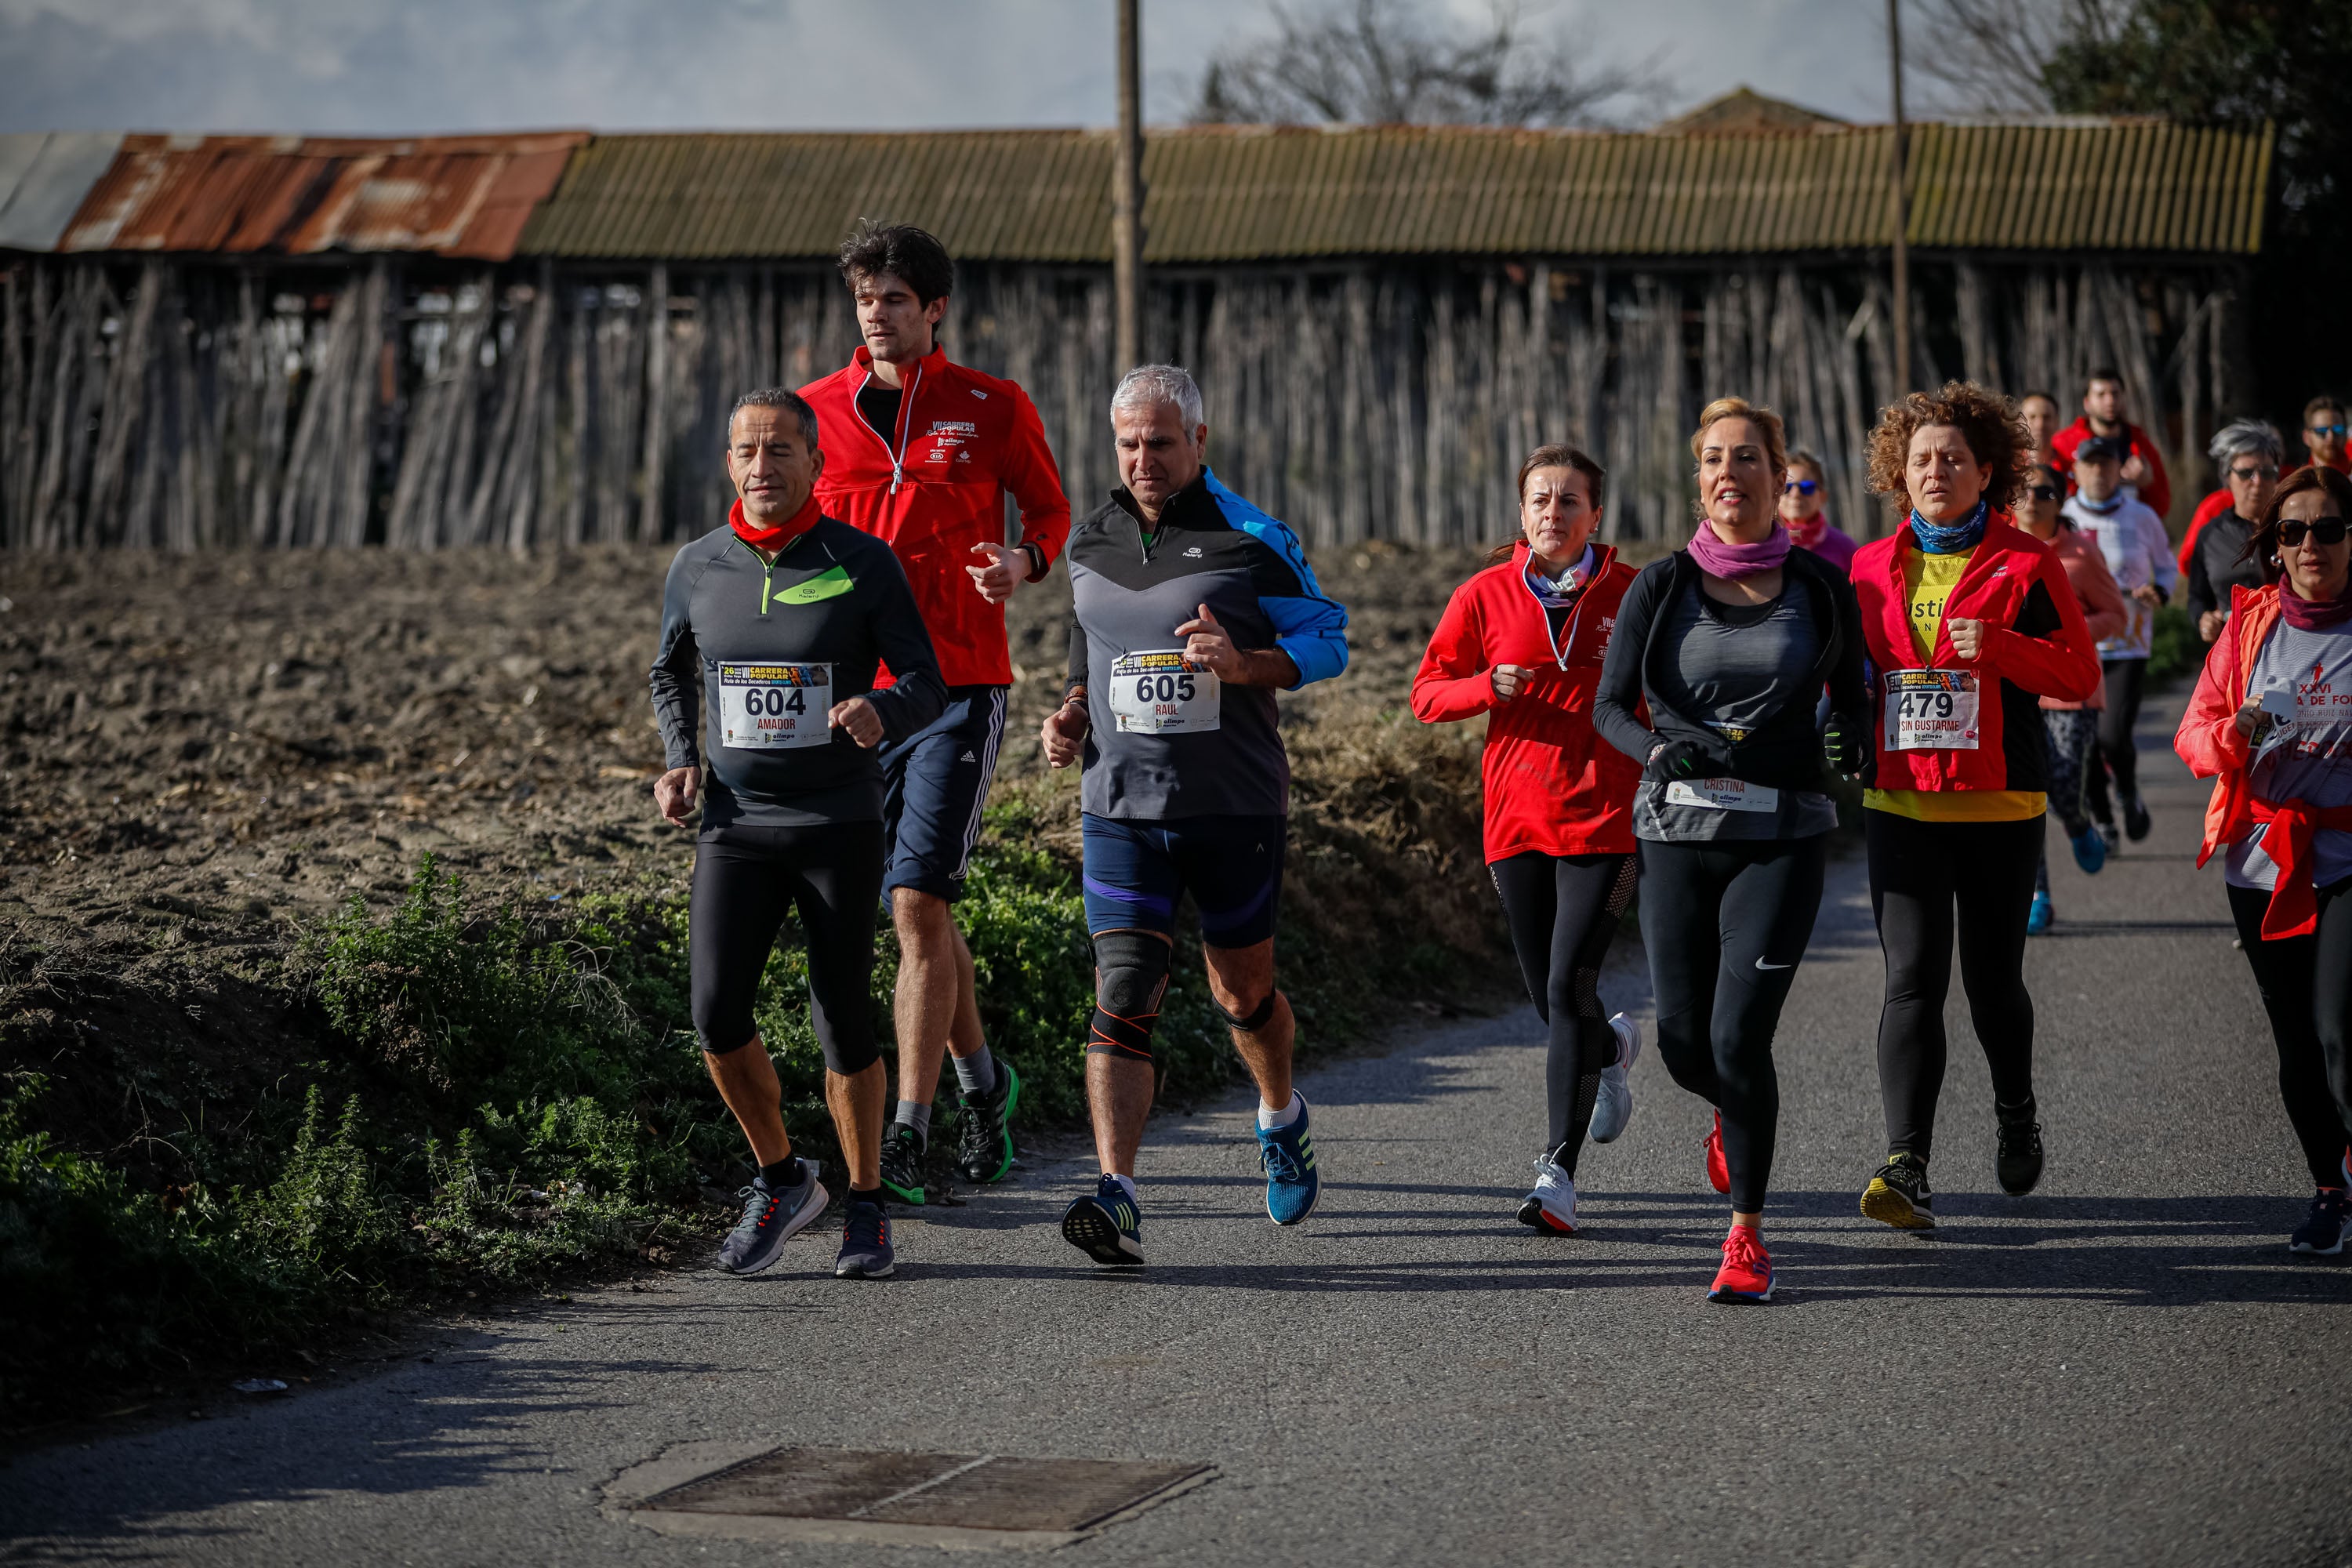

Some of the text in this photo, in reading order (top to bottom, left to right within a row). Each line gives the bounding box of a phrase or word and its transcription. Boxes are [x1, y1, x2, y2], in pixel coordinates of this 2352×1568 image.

[933, 421, 942, 430] VII
[1602, 616, 1611, 627] VII
[1136, 674, 1196, 702] 605
[2299, 684, 2331, 694] XXVI
[746, 688, 806, 716] 604
[1898, 693, 1953, 717] 479
[2310, 695, 2325, 706] DE
[2332, 695, 2352, 705] FO
[1156, 704, 1178, 715] RAUL
[757, 718, 795, 729] AMADOR
[1901, 720, 1912, 731] SIN
[1915, 720, 1959, 731] GUSTARME
[1704, 779, 1744, 793] CRISTINA
